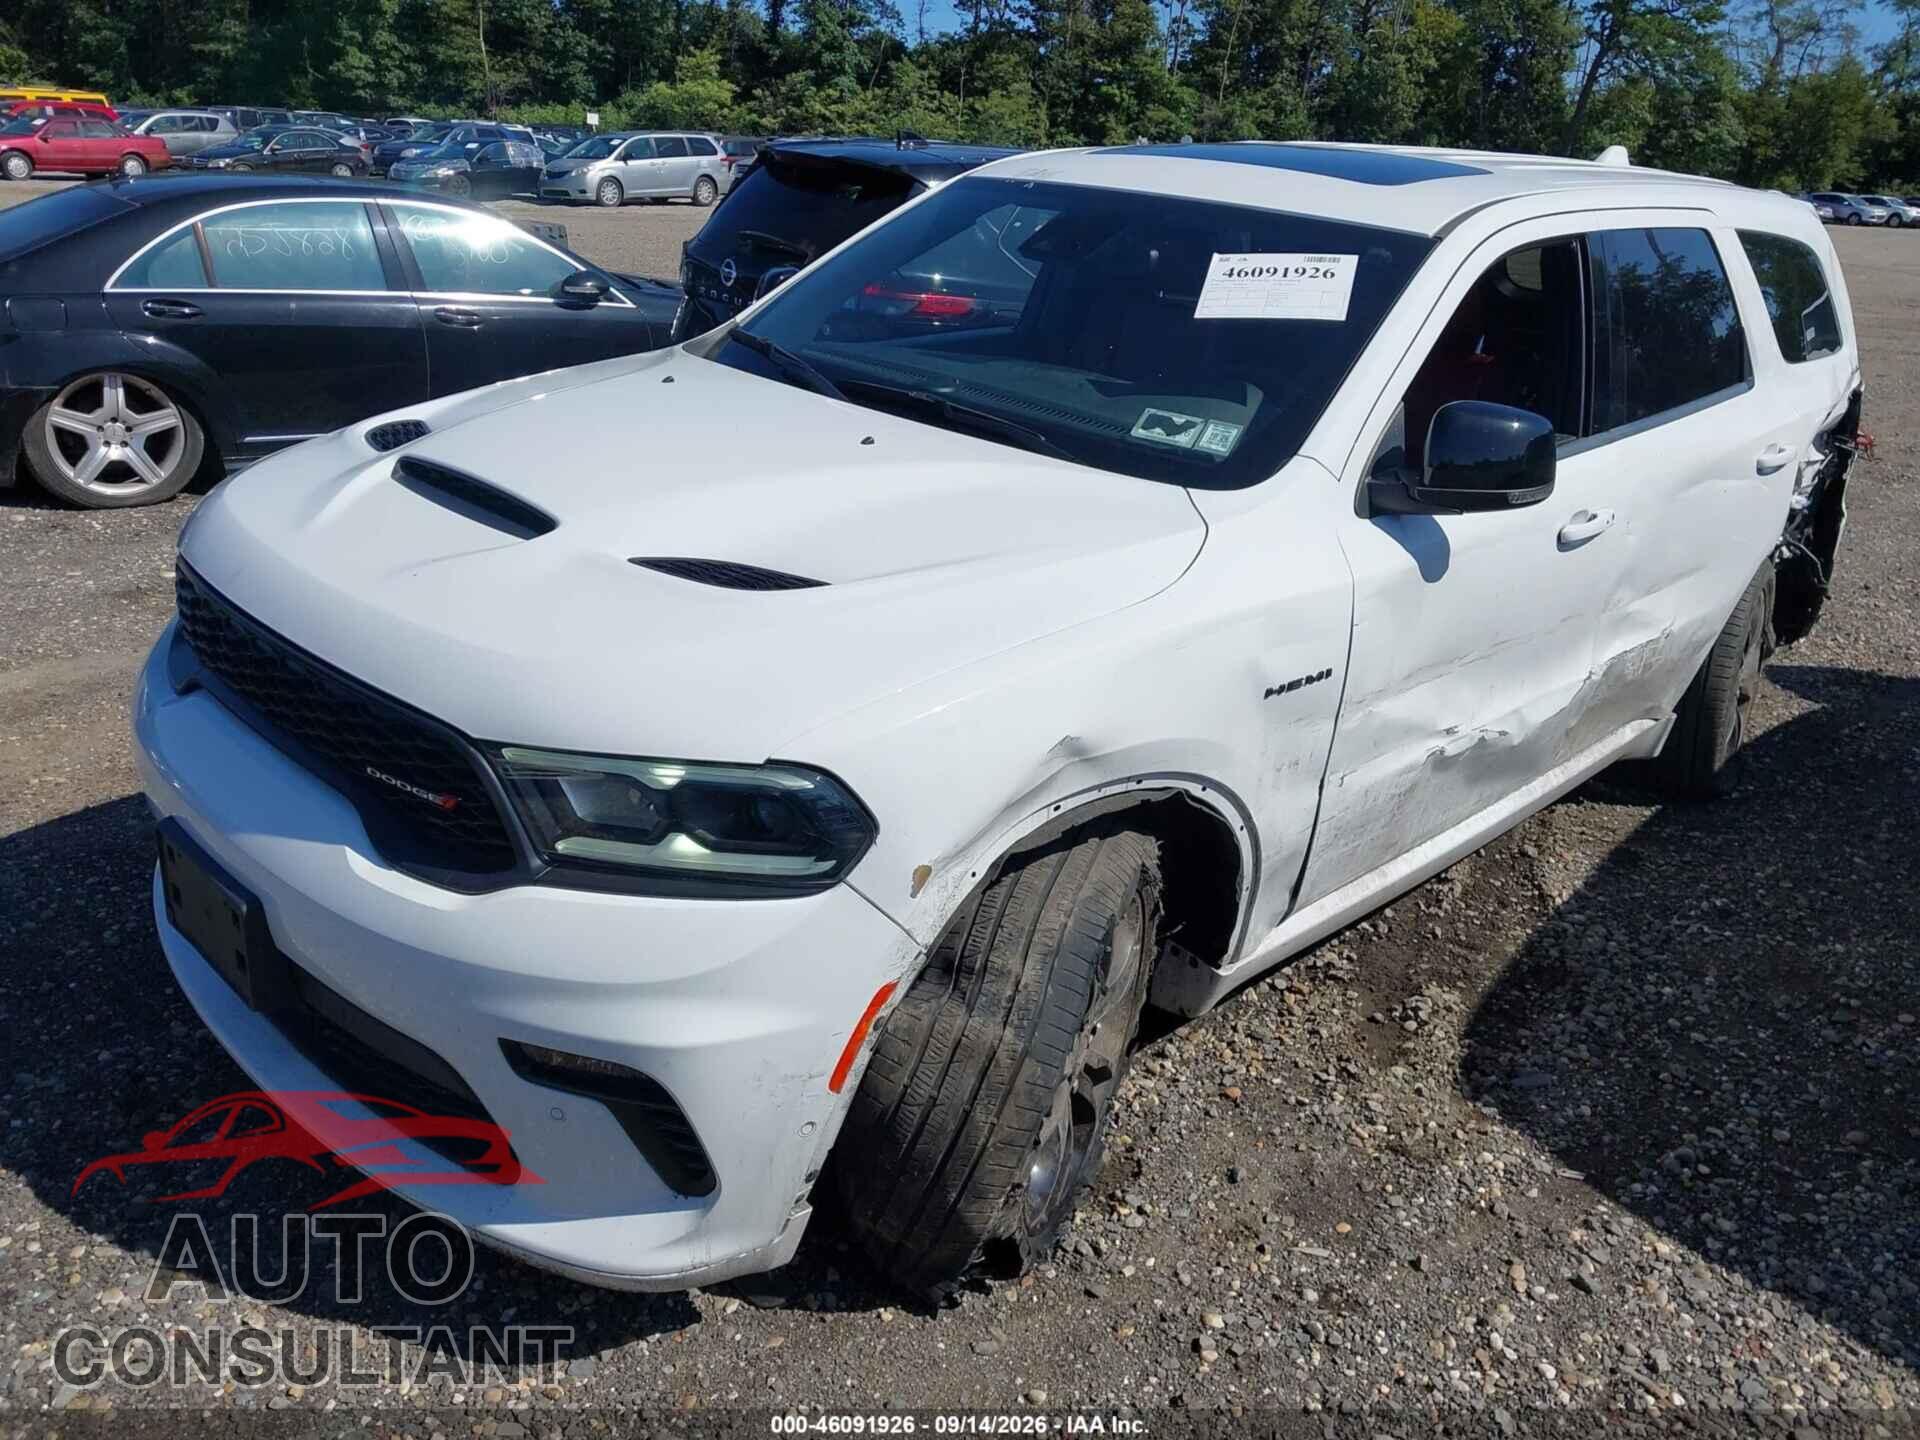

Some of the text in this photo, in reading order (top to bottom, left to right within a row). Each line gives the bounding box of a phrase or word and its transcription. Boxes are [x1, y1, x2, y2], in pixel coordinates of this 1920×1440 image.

[1222, 266, 1336, 279] 46091926
[1263, 667, 1332, 700] HEMI
[366, 767, 445, 806] DODGE
